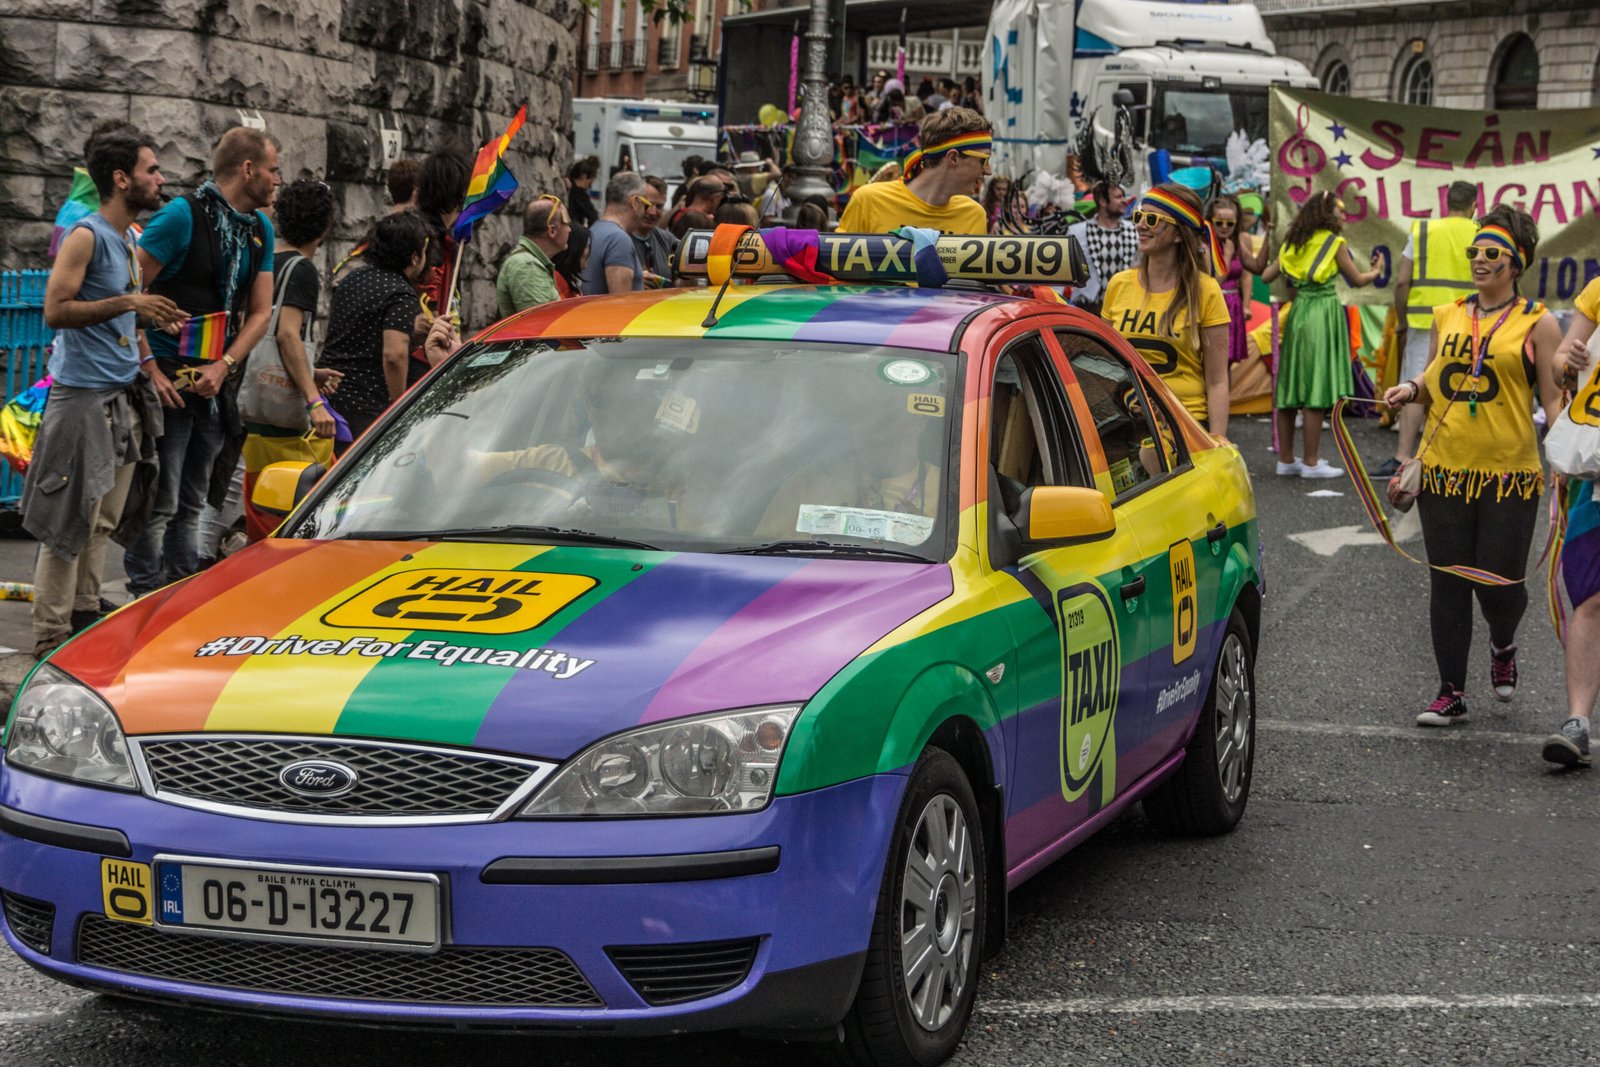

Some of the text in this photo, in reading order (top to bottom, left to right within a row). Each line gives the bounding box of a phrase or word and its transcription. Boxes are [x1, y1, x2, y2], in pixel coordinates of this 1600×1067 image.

[1360, 114, 1551, 170] SEÁN
[735, 237, 760, 248] HAIL
[936, 246, 957, 254] ICENCE
[825, 238, 918, 273] TAXI
[959, 240, 1063, 276] 21319
[914, 396, 940, 405] HAIL
[406, 575, 545, 597] HAIL
[1173, 557, 1193, 594] HAIL
[1068, 609, 1084, 628] 21319
[194, 634, 597, 679] #DriveForEquality
[1069, 639, 1112, 727] TAXI
[295, 767, 337, 787] Ford
[108, 864, 145, 888] HAIL
[257, 874, 286, 884] BAILE
[320, 879, 356, 889] CLIATH
[163, 900, 182, 914] IRL
[203, 879, 414, 935] 06-D-13227
